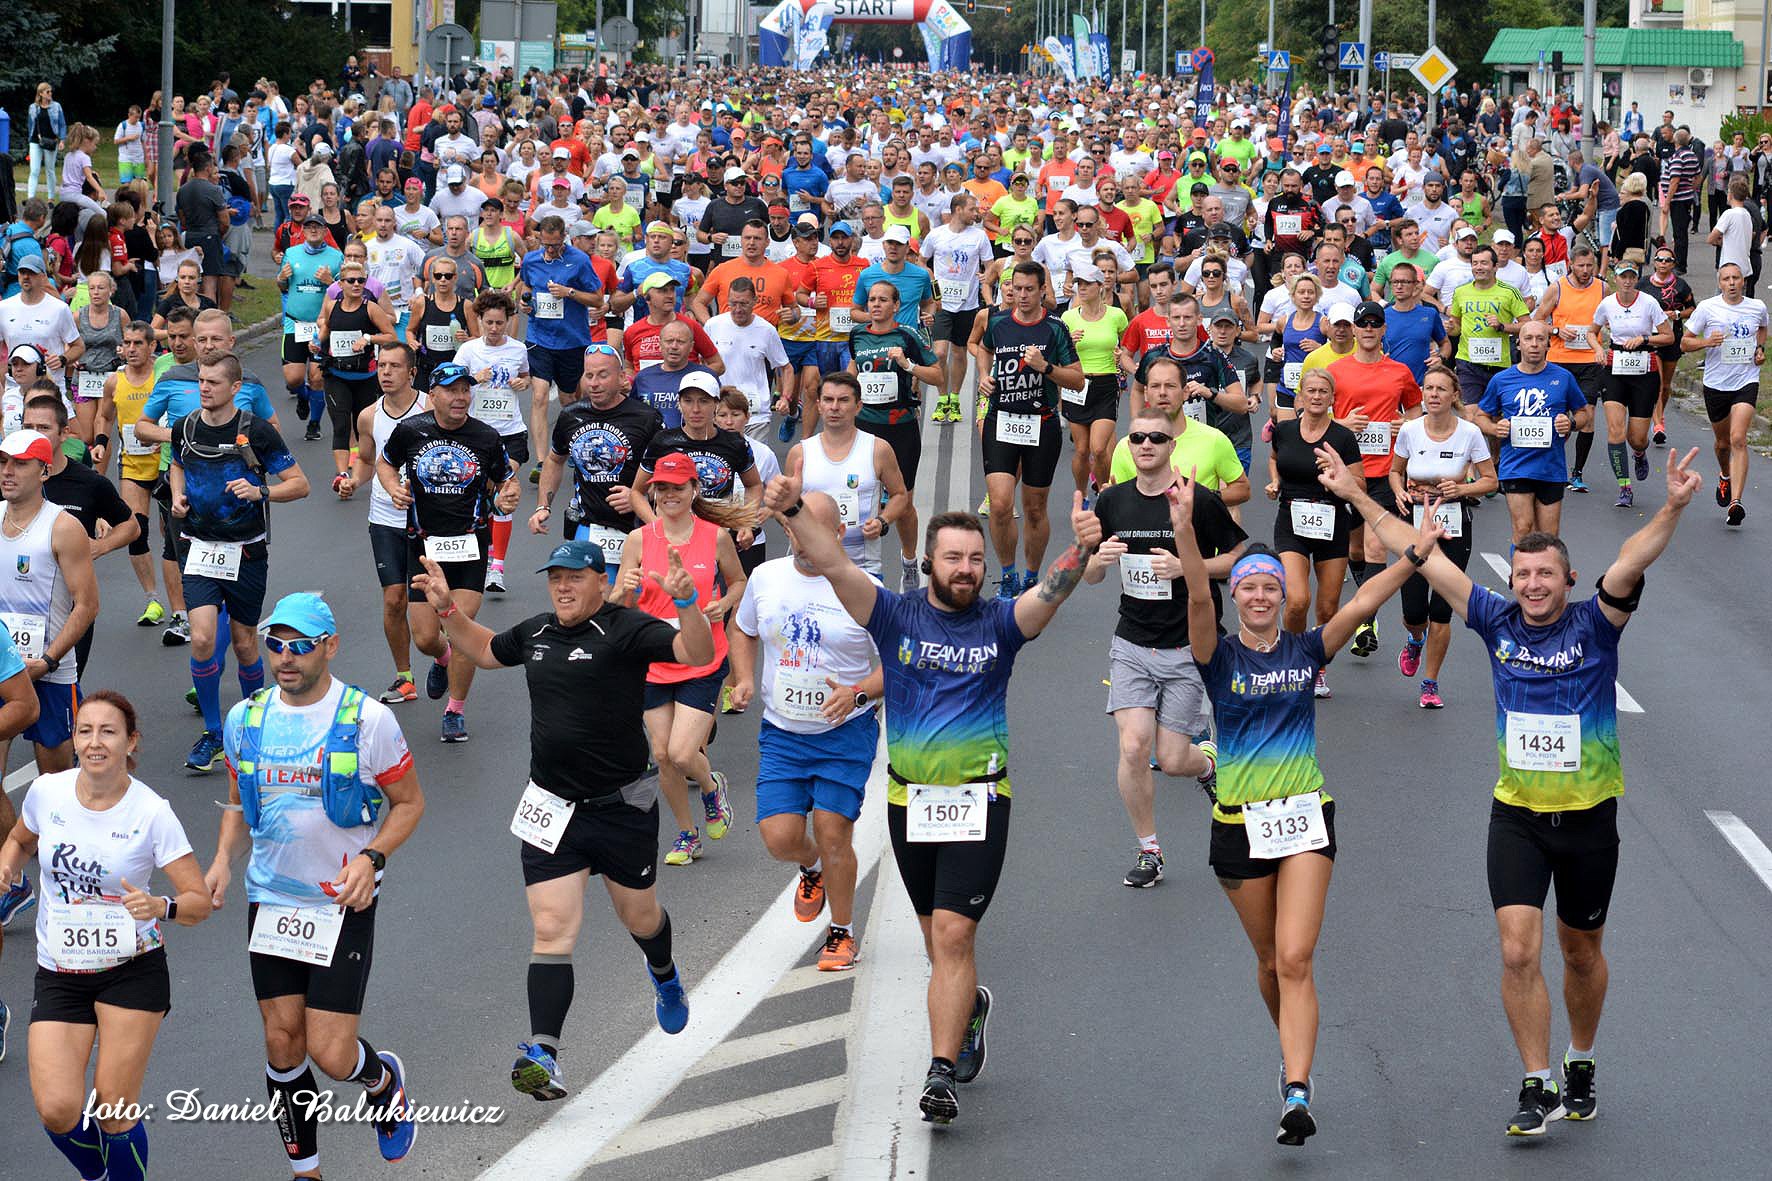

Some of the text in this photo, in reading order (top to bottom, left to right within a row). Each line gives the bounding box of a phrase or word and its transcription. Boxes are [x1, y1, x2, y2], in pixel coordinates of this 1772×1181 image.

[833, 0, 897, 18] START
[943, 287, 963, 297] 2751
[1465, 300, 1502, 314] RUN
[1473, 346, 1496, 356] 3664
[1730, 347, 1748, 356] 371
[1619, 358, 1641, 368] 1582
[866, 383, 886, 394] 937
[998, 374, 1043, 393] TEAM
[1000, 388, 1044, 404] EXTREME
[482, 399, 509, 411] 2397
[1005, 423, 1033, 436] 3662
[1518, 427, 1545, 438] 1055
[1357, 433, 1384, 445] 2288
[590, 474, 621, 483] BIEGU
[1301, 515, 1324, 528] 345
[435, 540, 468, 553] 2657
[201, 551, 226, 566] 718
[1127, 569, 1160, 584] 1454
[920, 641, 965, 661] TEAM
[1250, 667, 1313, 686] TEAM RUN
[785, 688, 825, 706] 2119
[1519, 734, 1565, 753] 1434
[923, 804, 971, 822] 1507
[1261, 815, 1310, 839] 3133
[52, 843, 103, 877] Run
[276, 916, 316, 941] 630
[63, 928, 119, 948] 3615
